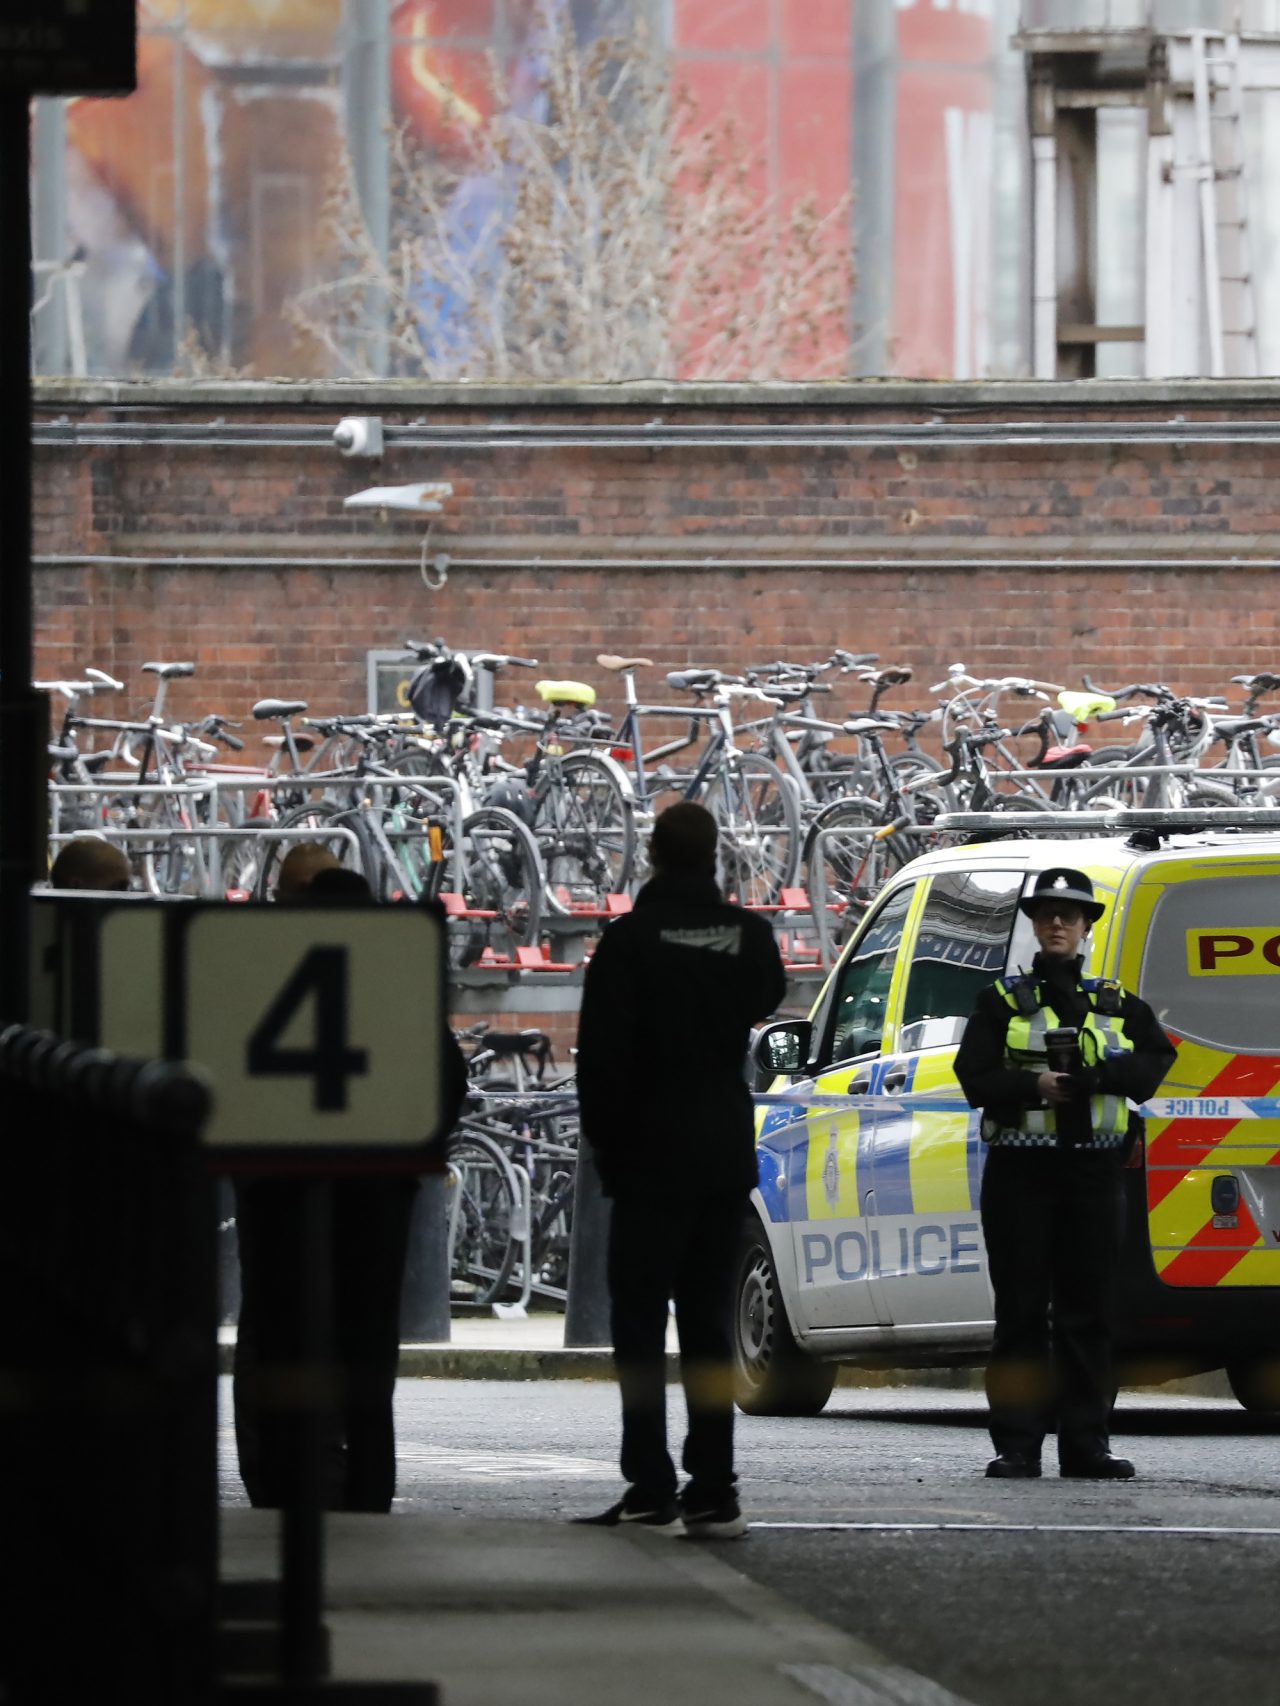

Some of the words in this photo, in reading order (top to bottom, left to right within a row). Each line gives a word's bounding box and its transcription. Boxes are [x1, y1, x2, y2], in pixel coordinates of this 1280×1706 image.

[246, 943, 369, 1113] 4
[1165, 1099, 1229, 1116] POLICE
[801, 1222, 981, 1284] POLICE
